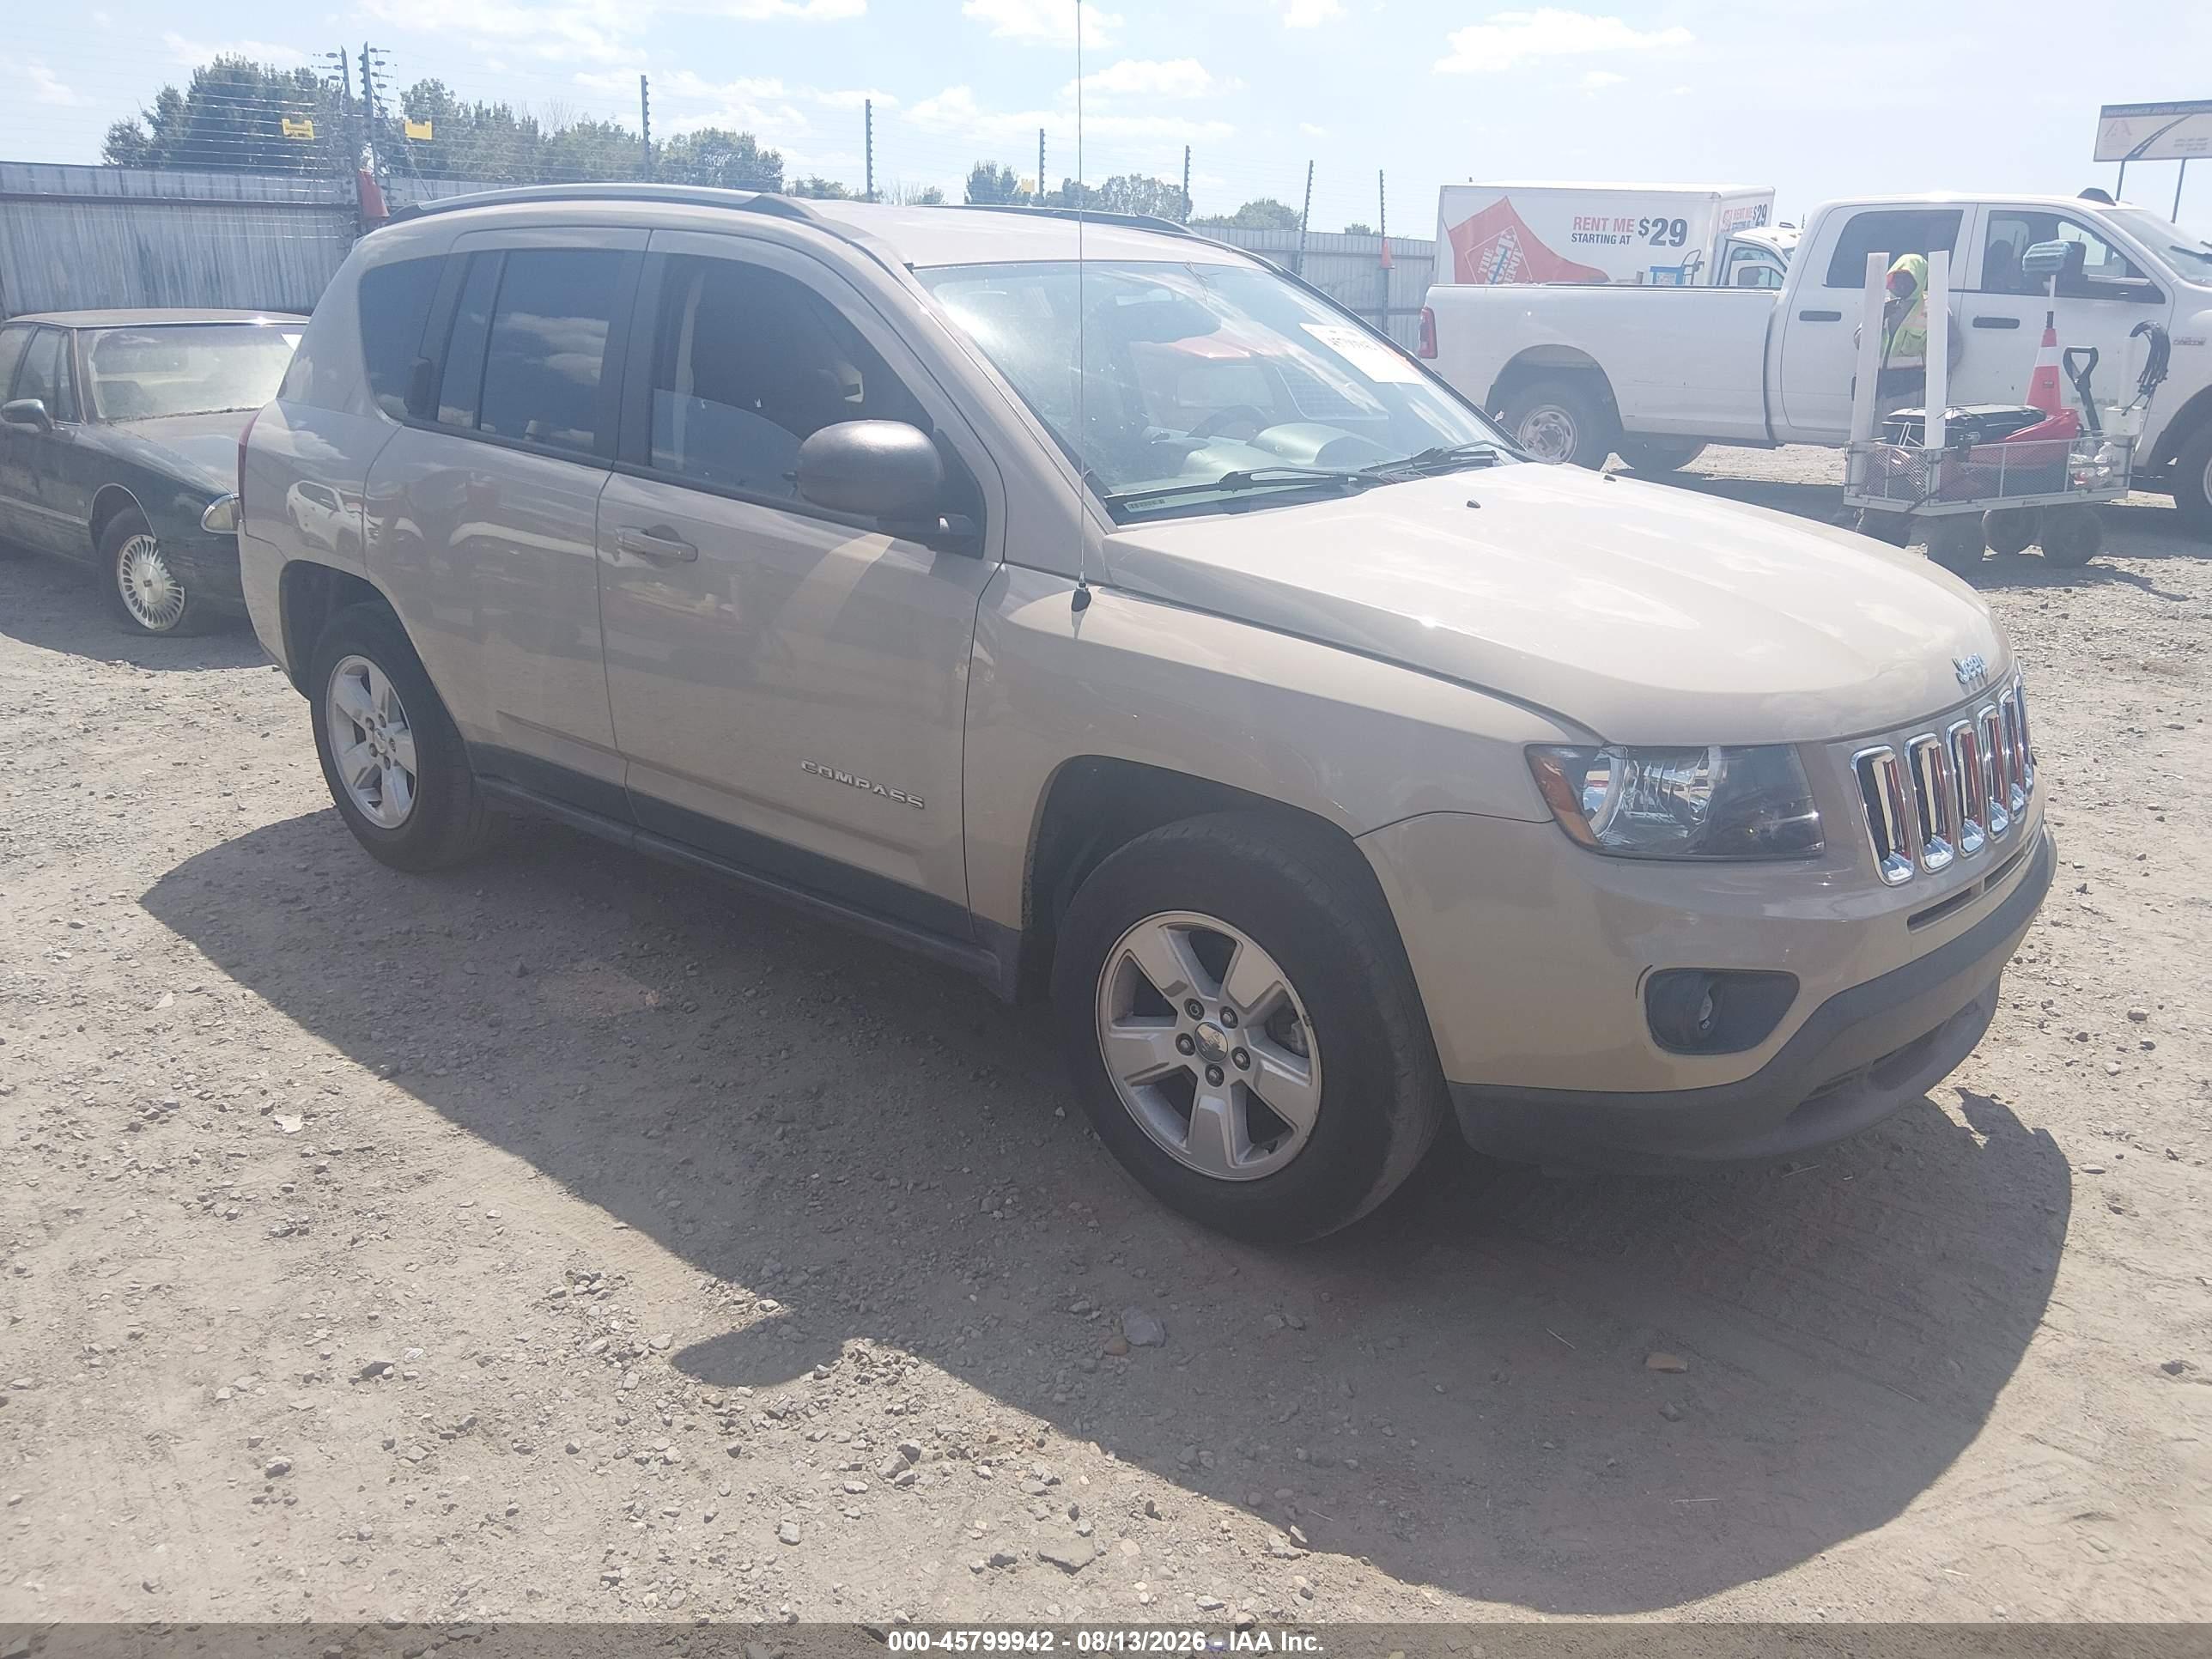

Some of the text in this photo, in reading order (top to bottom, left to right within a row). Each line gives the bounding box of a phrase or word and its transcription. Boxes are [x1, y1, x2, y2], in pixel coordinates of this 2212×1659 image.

[1572, 216, 1636, 234] RENT ME
[1638, 216, 1688, 248] $29
[1571, 232, 1632, 246] STARTING AT
[1477, 247, 1494, 274] THE
[799, 759, 926, 810] COMPASS
